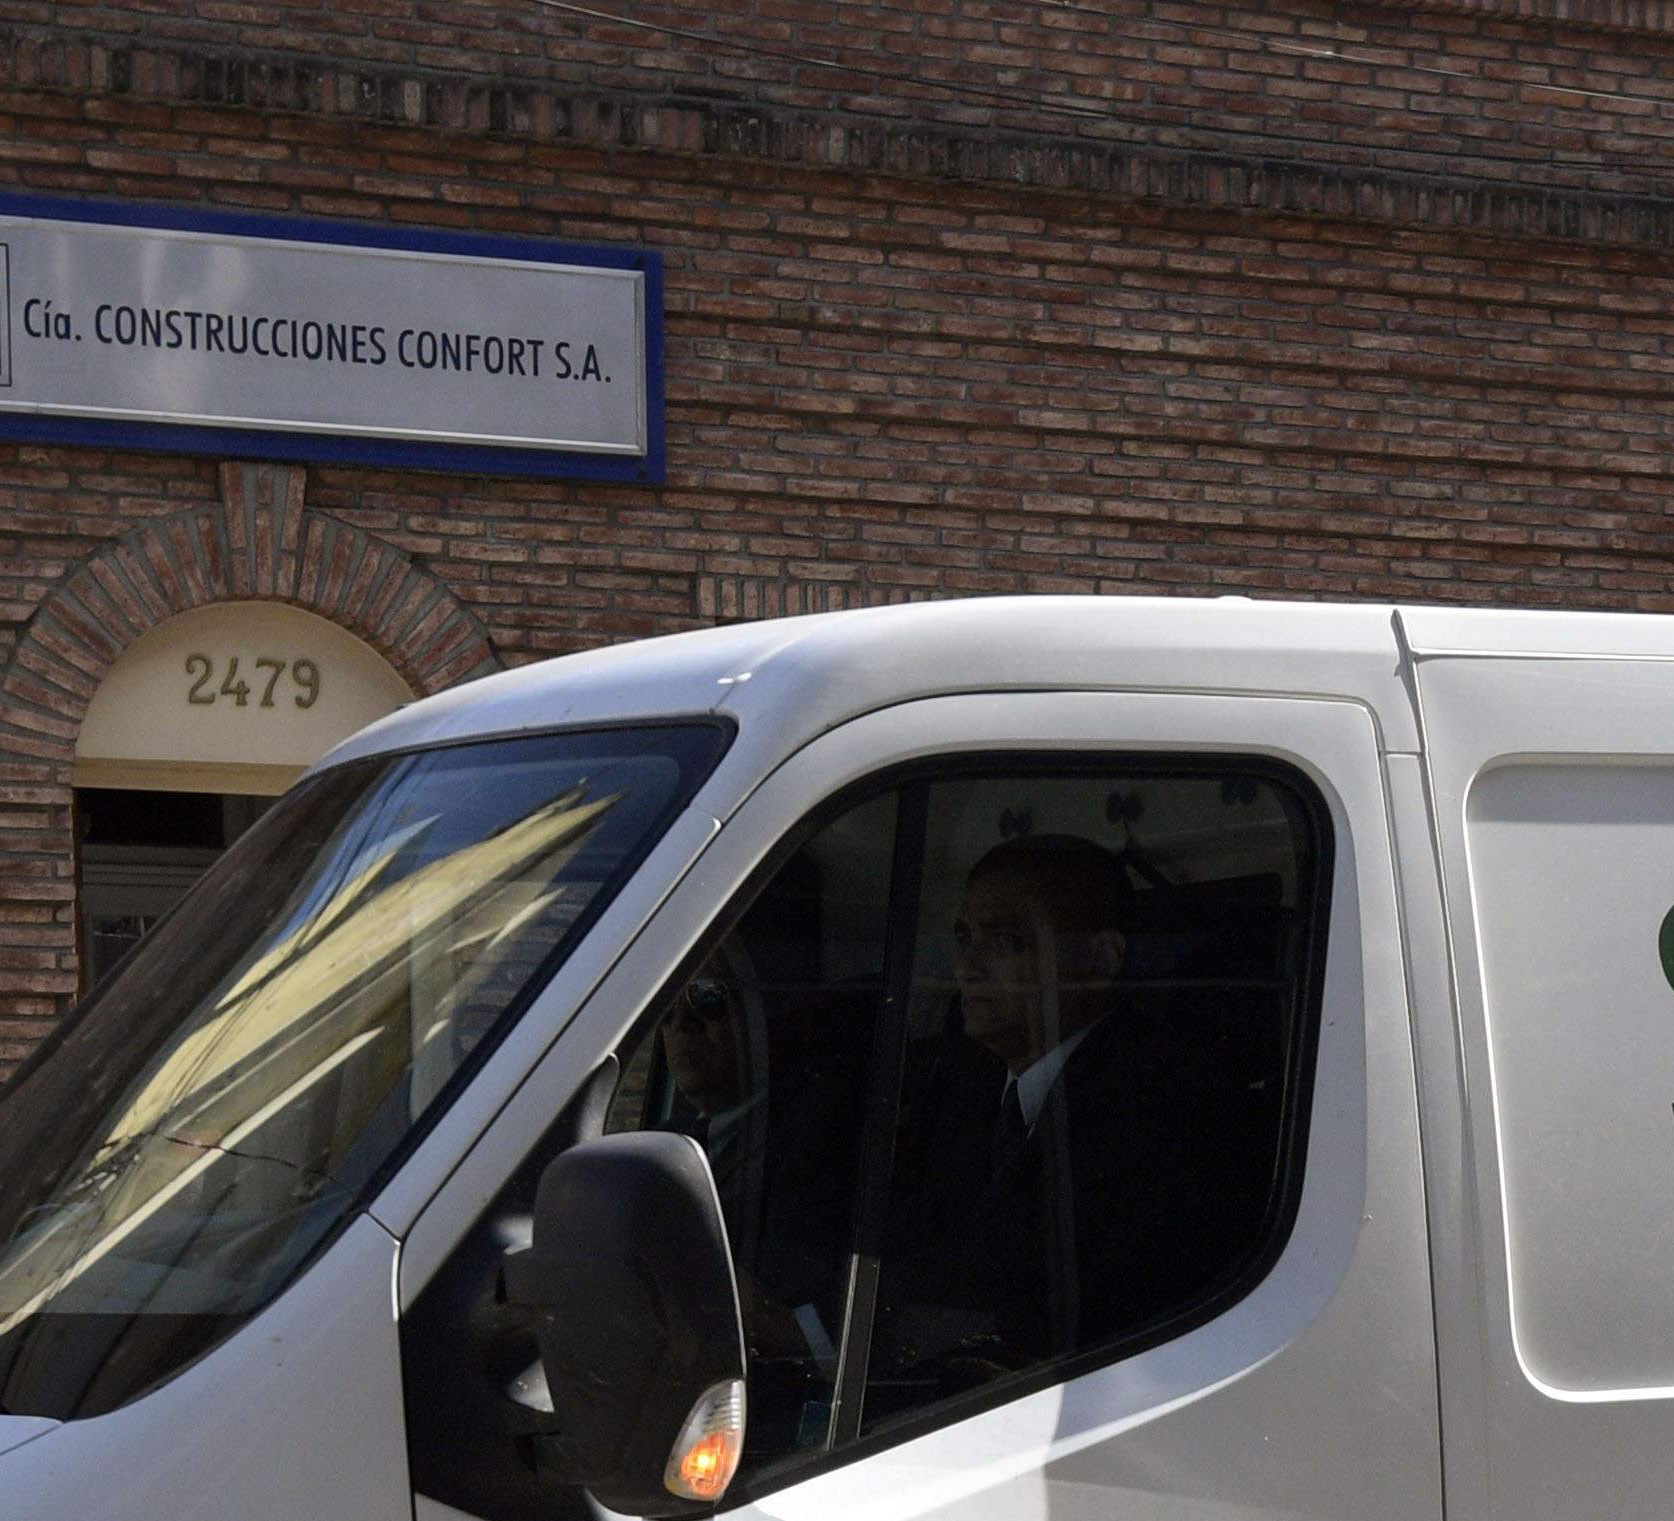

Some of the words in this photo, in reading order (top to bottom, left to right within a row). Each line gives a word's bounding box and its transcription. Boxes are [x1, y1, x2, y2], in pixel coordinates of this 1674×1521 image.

[23, 298, 82, 342] Cía.
[94, 304, 387, 366] CONSTRUCCIONES
[397, 329, 545, 377] CONFORT
[554, 341, 612, 383] S.A.
[184, 650, 322, 710] 2479
